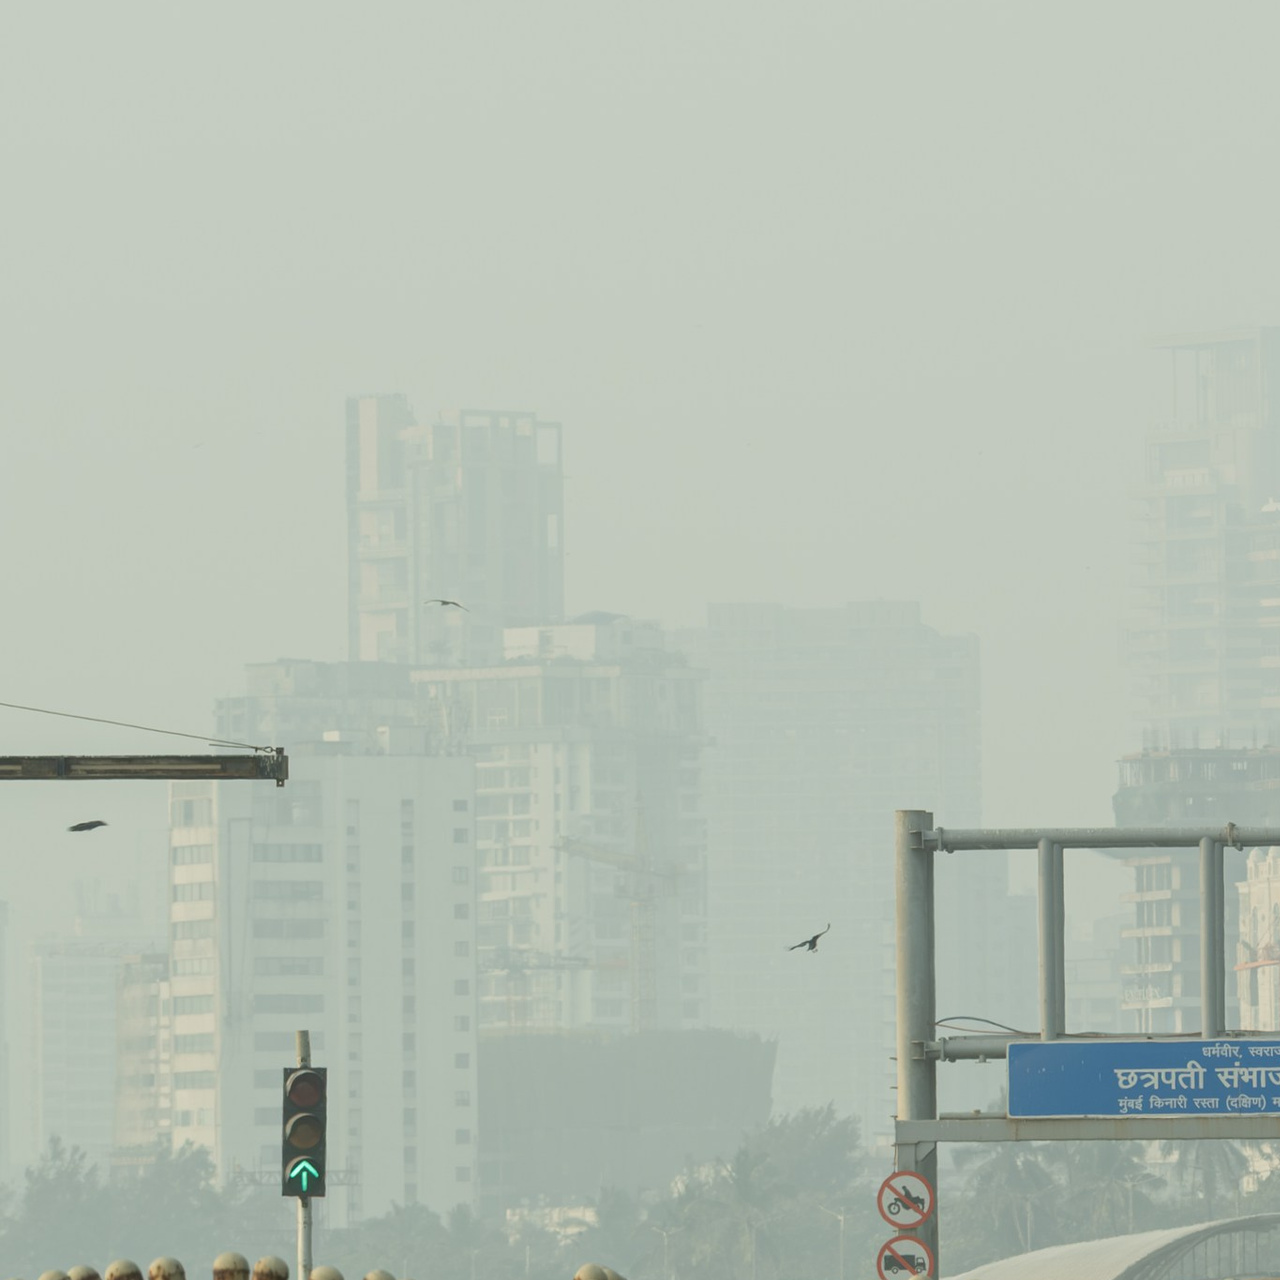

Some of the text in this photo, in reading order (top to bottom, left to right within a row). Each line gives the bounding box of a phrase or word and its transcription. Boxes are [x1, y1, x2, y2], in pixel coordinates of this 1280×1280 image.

[1202, 1043, 1243, 1058] धर्मवीर,
[1113, 1060, 1207, 1090] छत्रपती
[1118, 1095, 1143, 1114] मुंबई
[1150, 1094, 1188, 1109] किनारी
[1193, 1097, 1219, 1109] रस्ता
[1226, 1094, 1266, 1111] (दक्षिण)
